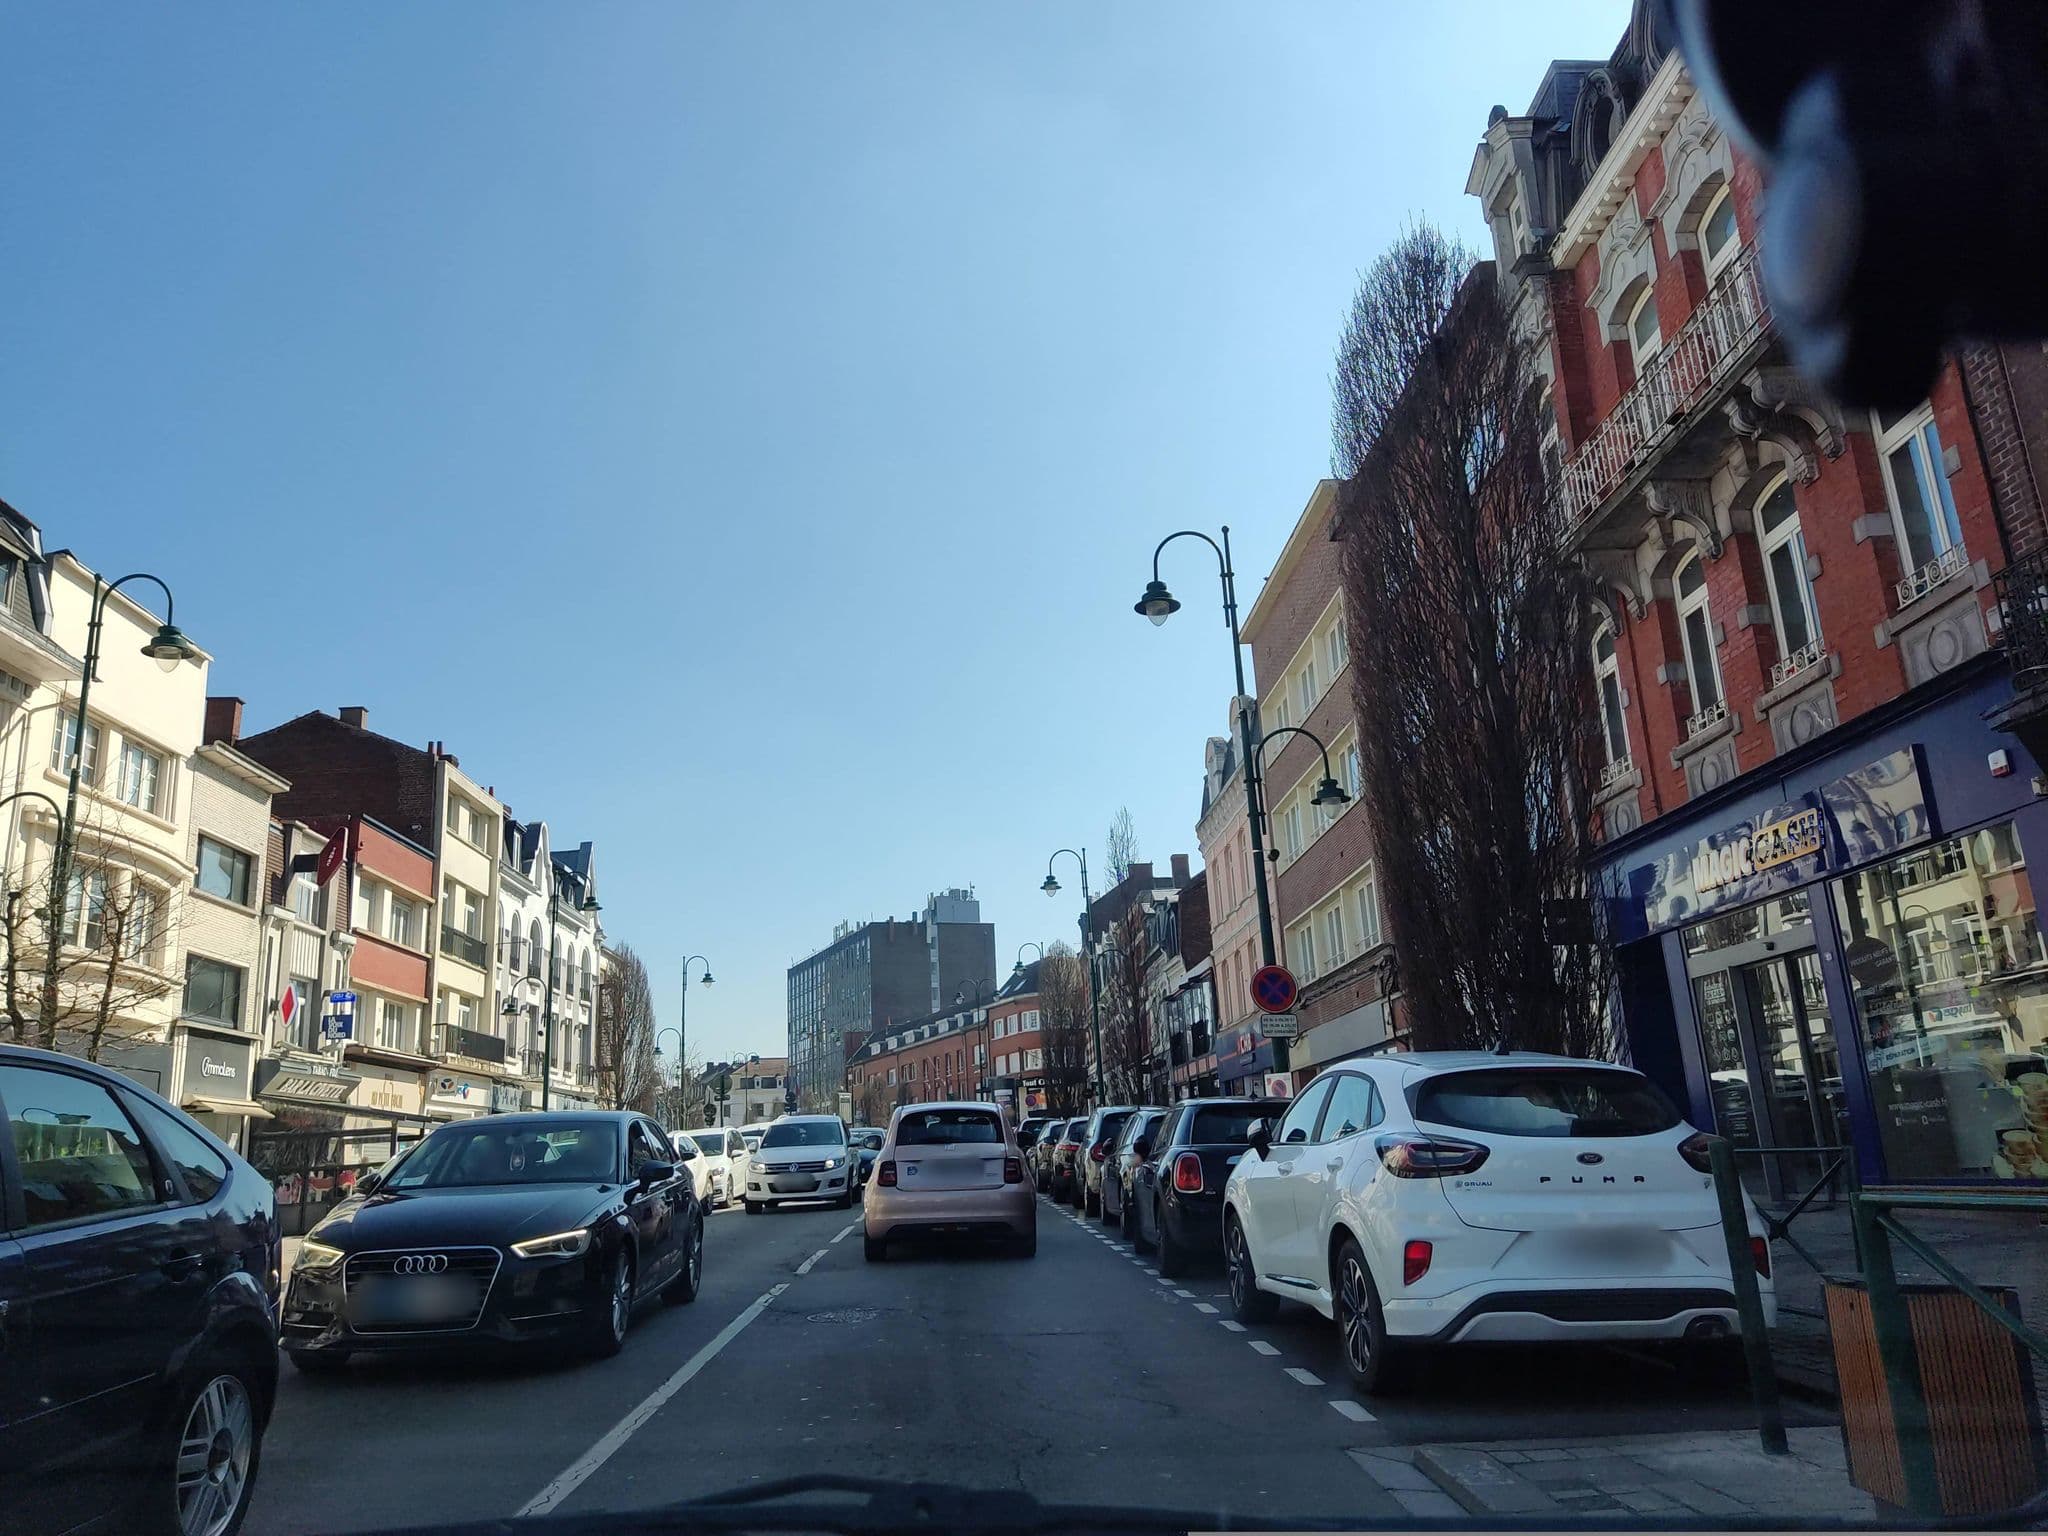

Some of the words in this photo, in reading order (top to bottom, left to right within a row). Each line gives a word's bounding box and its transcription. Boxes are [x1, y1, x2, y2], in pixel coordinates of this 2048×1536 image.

[1692, 836, 1754, 893] MAGIC
[1755, 814, 1818, 864] CASH
[1540, 1176, 1645, 1184] PUMA
